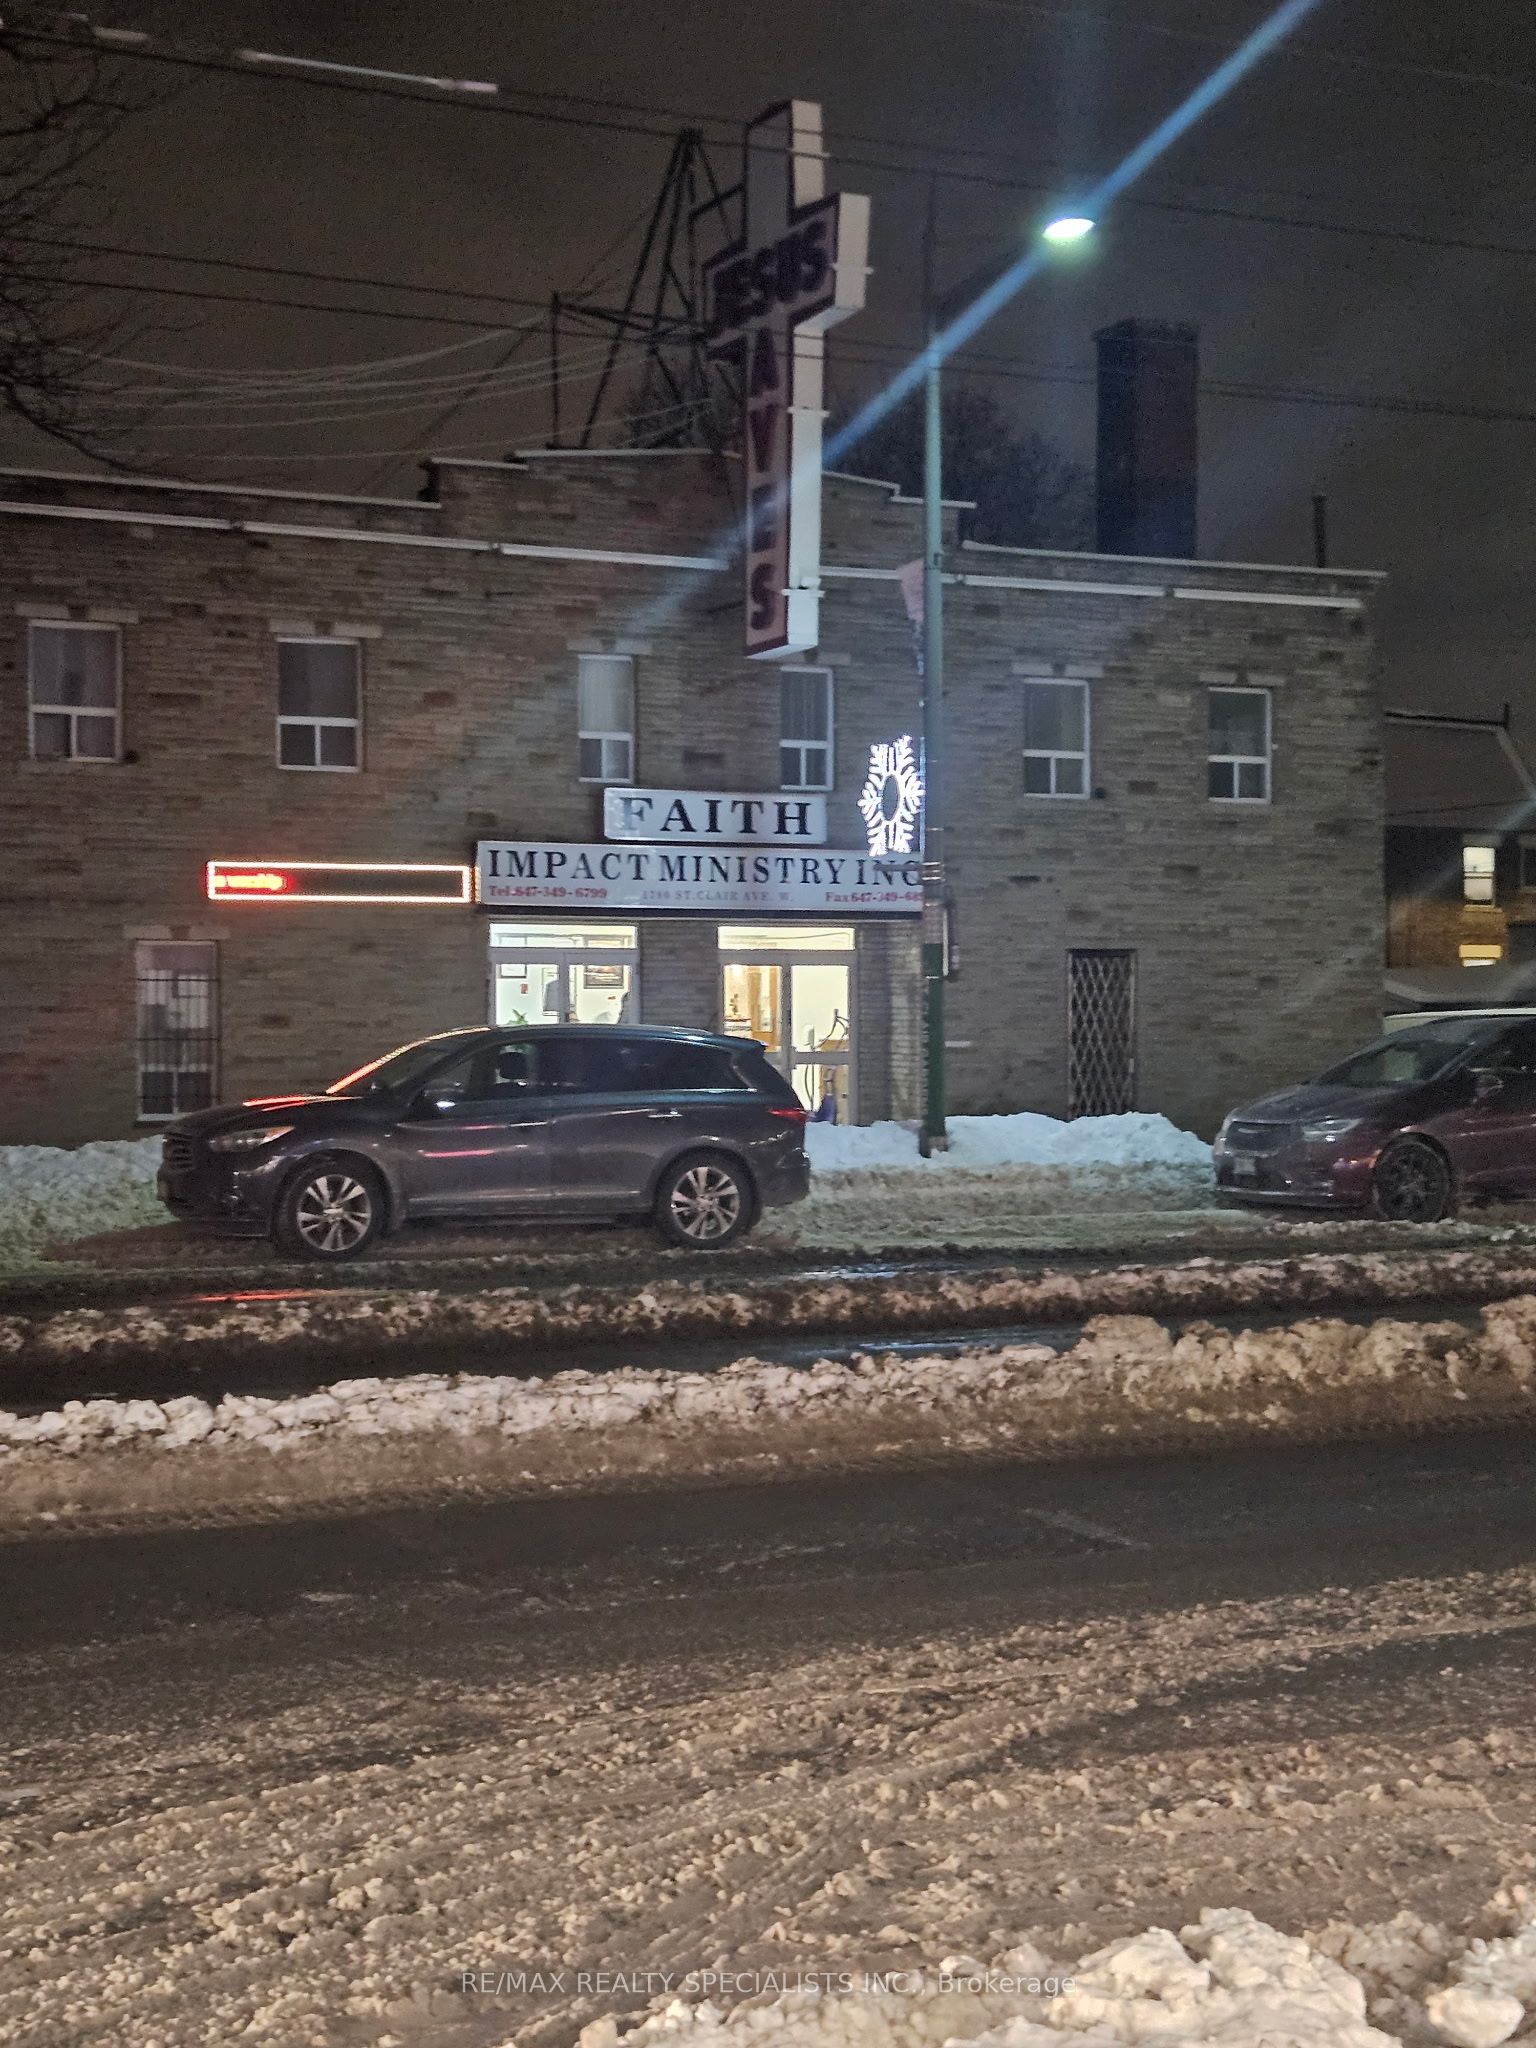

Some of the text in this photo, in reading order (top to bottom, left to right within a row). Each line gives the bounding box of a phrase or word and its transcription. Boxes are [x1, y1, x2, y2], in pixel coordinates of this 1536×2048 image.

[619, 796, 812, 836] FAITH
[488, 849, 650, 882] IMPACT
[659, 854, 846, 885] MINISTRY
